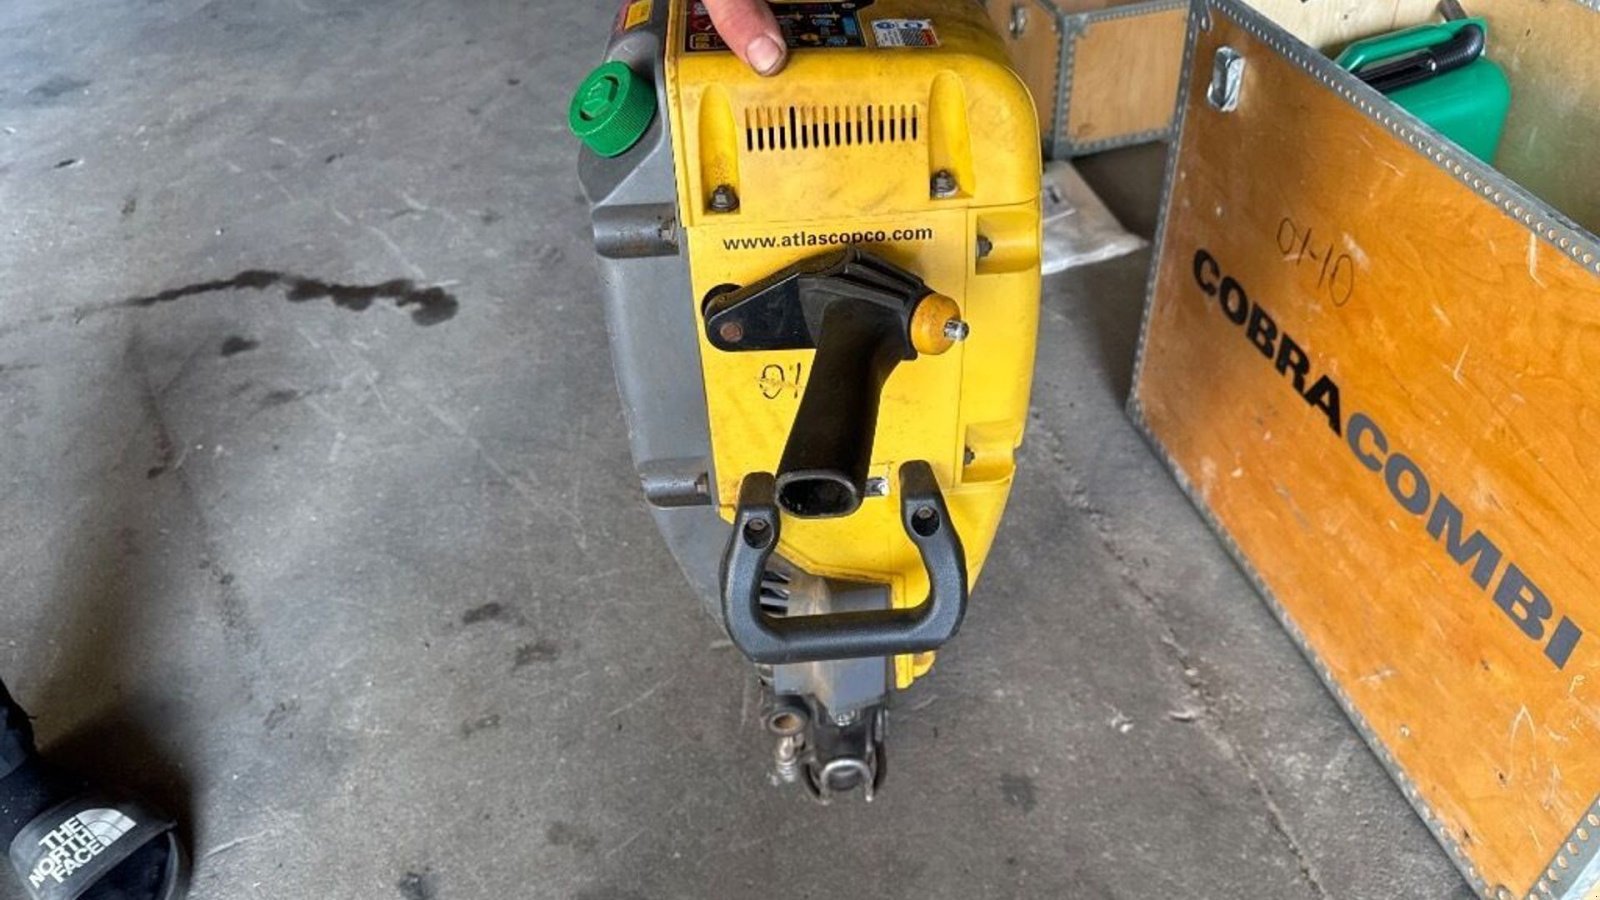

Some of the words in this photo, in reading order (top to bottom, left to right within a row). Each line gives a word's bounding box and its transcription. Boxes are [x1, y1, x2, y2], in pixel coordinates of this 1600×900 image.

[723, 227, 933, 250] www.atlascopco.com
[38, 815, 83, 850] THE
[28, 829, 96, 889] NORTH
[51, 840, 106, 884] FACE
